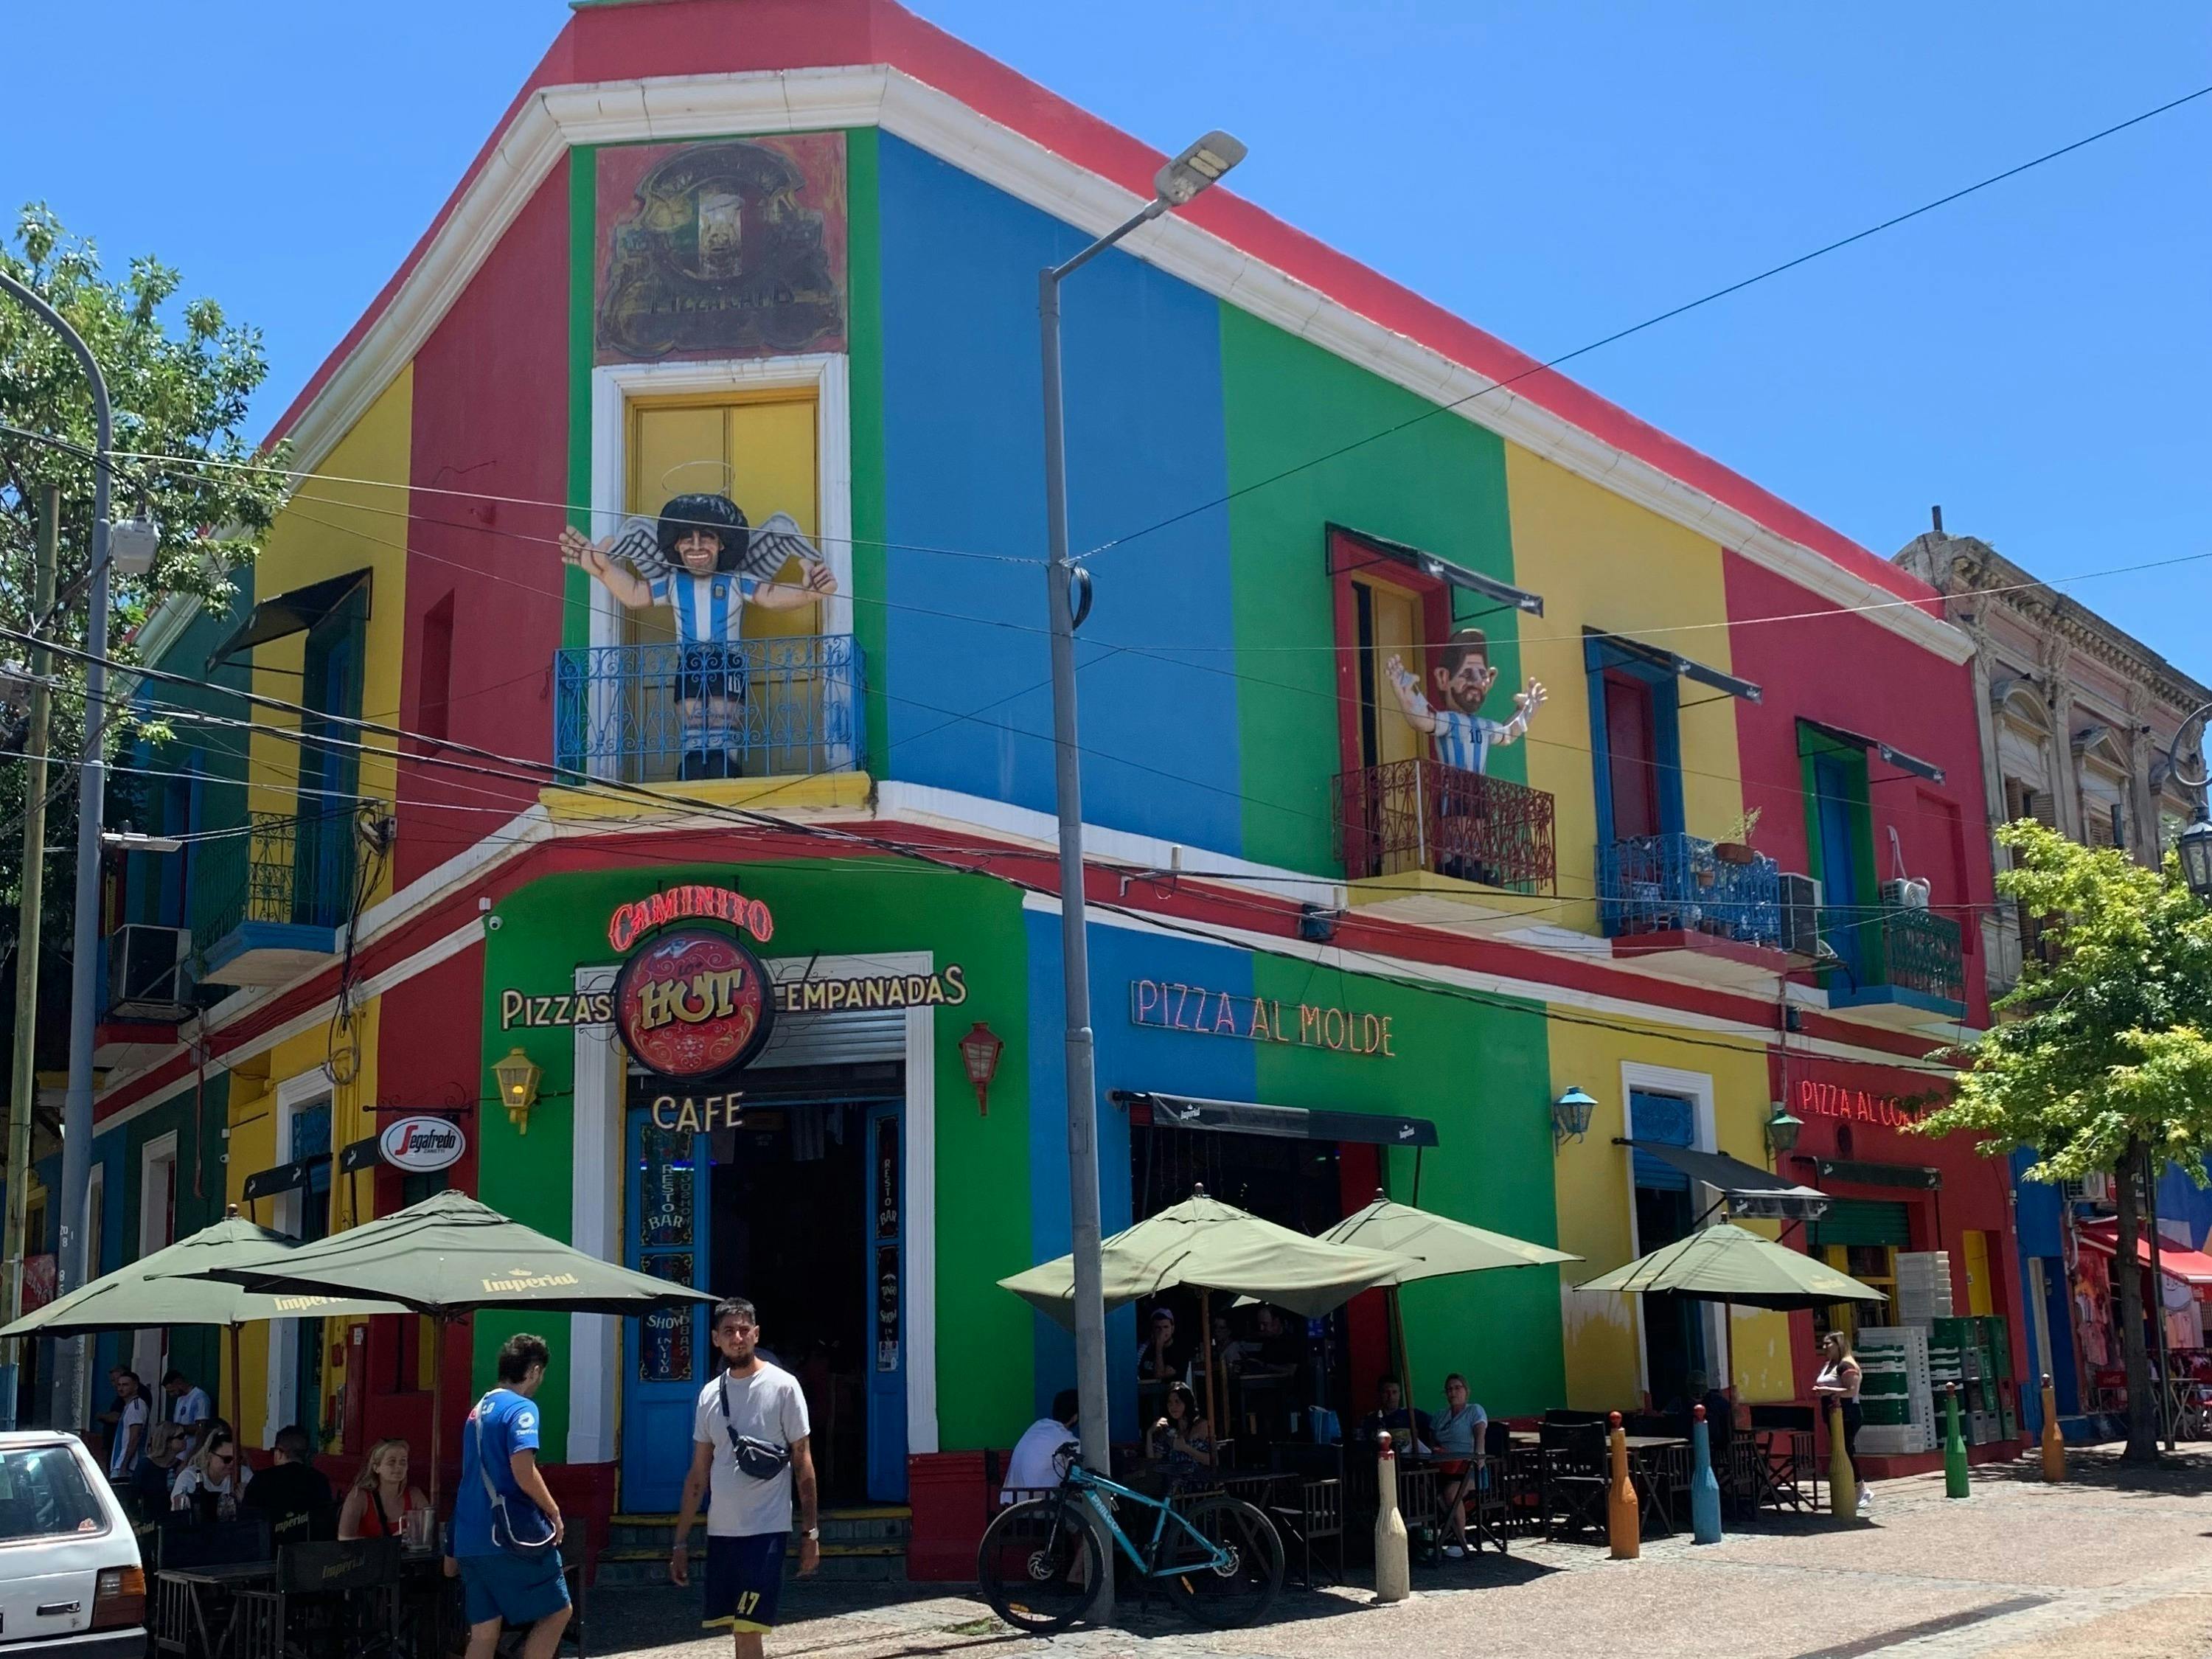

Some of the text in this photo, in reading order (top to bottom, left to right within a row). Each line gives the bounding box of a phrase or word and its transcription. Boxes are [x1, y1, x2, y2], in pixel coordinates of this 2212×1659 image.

[1470, 729, 1483, 745] 10
[609, 885, 773, 952] CAMINITO
[638, 968, 742, 1031] HOT
[787, 966, 967, 1011] EMPANADAS
[502, 991, 613, 1030] PIZZAS
[1138, 980, 1396, 1056] PIZZA AL MOLDE
[653, 1092, 744, 1132] CAFE
[1802, 1080, 1851, 1119] PIZZA
[1858, 1091, 1877, 1121] AL
[394, 1125, 456, 1155] Segafredo
[661, 1164, 675, 1213] RESTO
[884, 1158, 892, 1206] RESTO
[648, 1214, 684, 1230] BAR
[480, 1273, 579, 1293] Imperial
[647, 1315, 684, 1329] SHOW
[1091, 1495, 1119, 1530] PHILCO
[737, 1591, 759, 1615] 47
